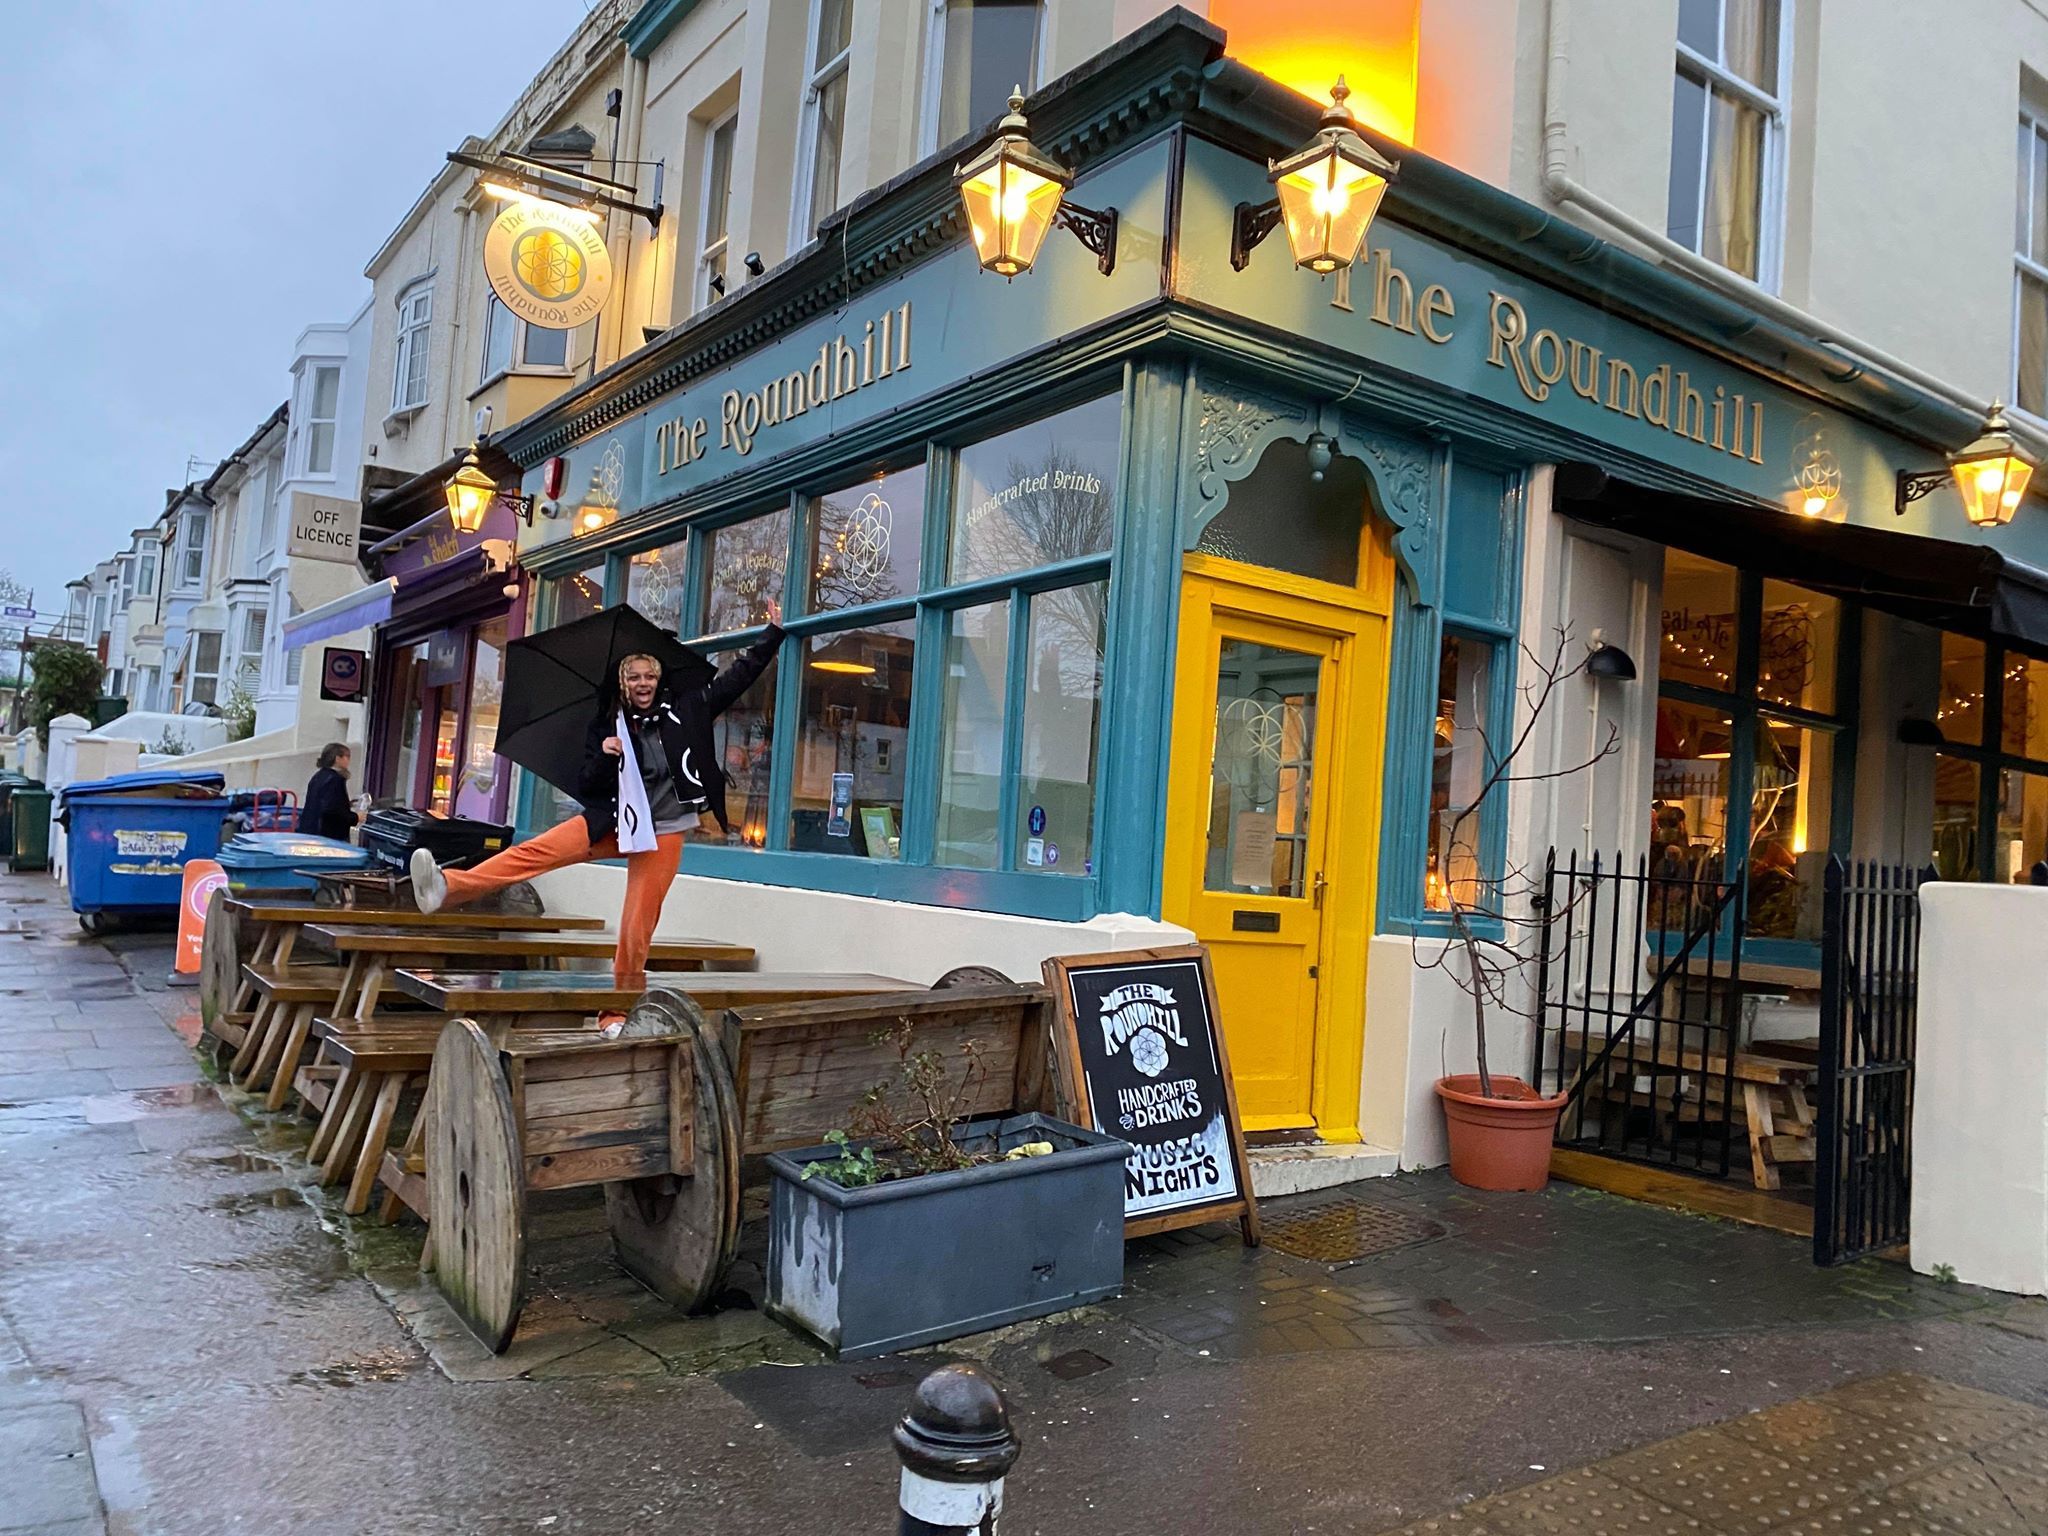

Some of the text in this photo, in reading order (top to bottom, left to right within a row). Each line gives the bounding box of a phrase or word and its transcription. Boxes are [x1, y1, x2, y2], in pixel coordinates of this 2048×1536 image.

[497, 210, 526, 235] The
[495, 275, 600, 324] The Roundhill
[655, 300, 913, 476] The Roundhill
[1486, 289, 1765, 466] Roundhill
[313, 510, 340, 526] OFF
[965, 469, 1101, 528] Handcrafted Drinks
[296, 525, 353, 548] LICENCE
[1661, 606, 1729, 650] eal Ale
[1117, 983, 1154, 1002] THE
[1099, 1001, 1189, 1057] ROUNDHILL
[1117, 1078, 1198, 1115] HANDCRAFTED
[1134, 1090, 1203, 1129] DRINKS
[1125, 1132, 1206, 1170] MUSIC
[1125, 1154, 1220, 1200] NIGHTS
